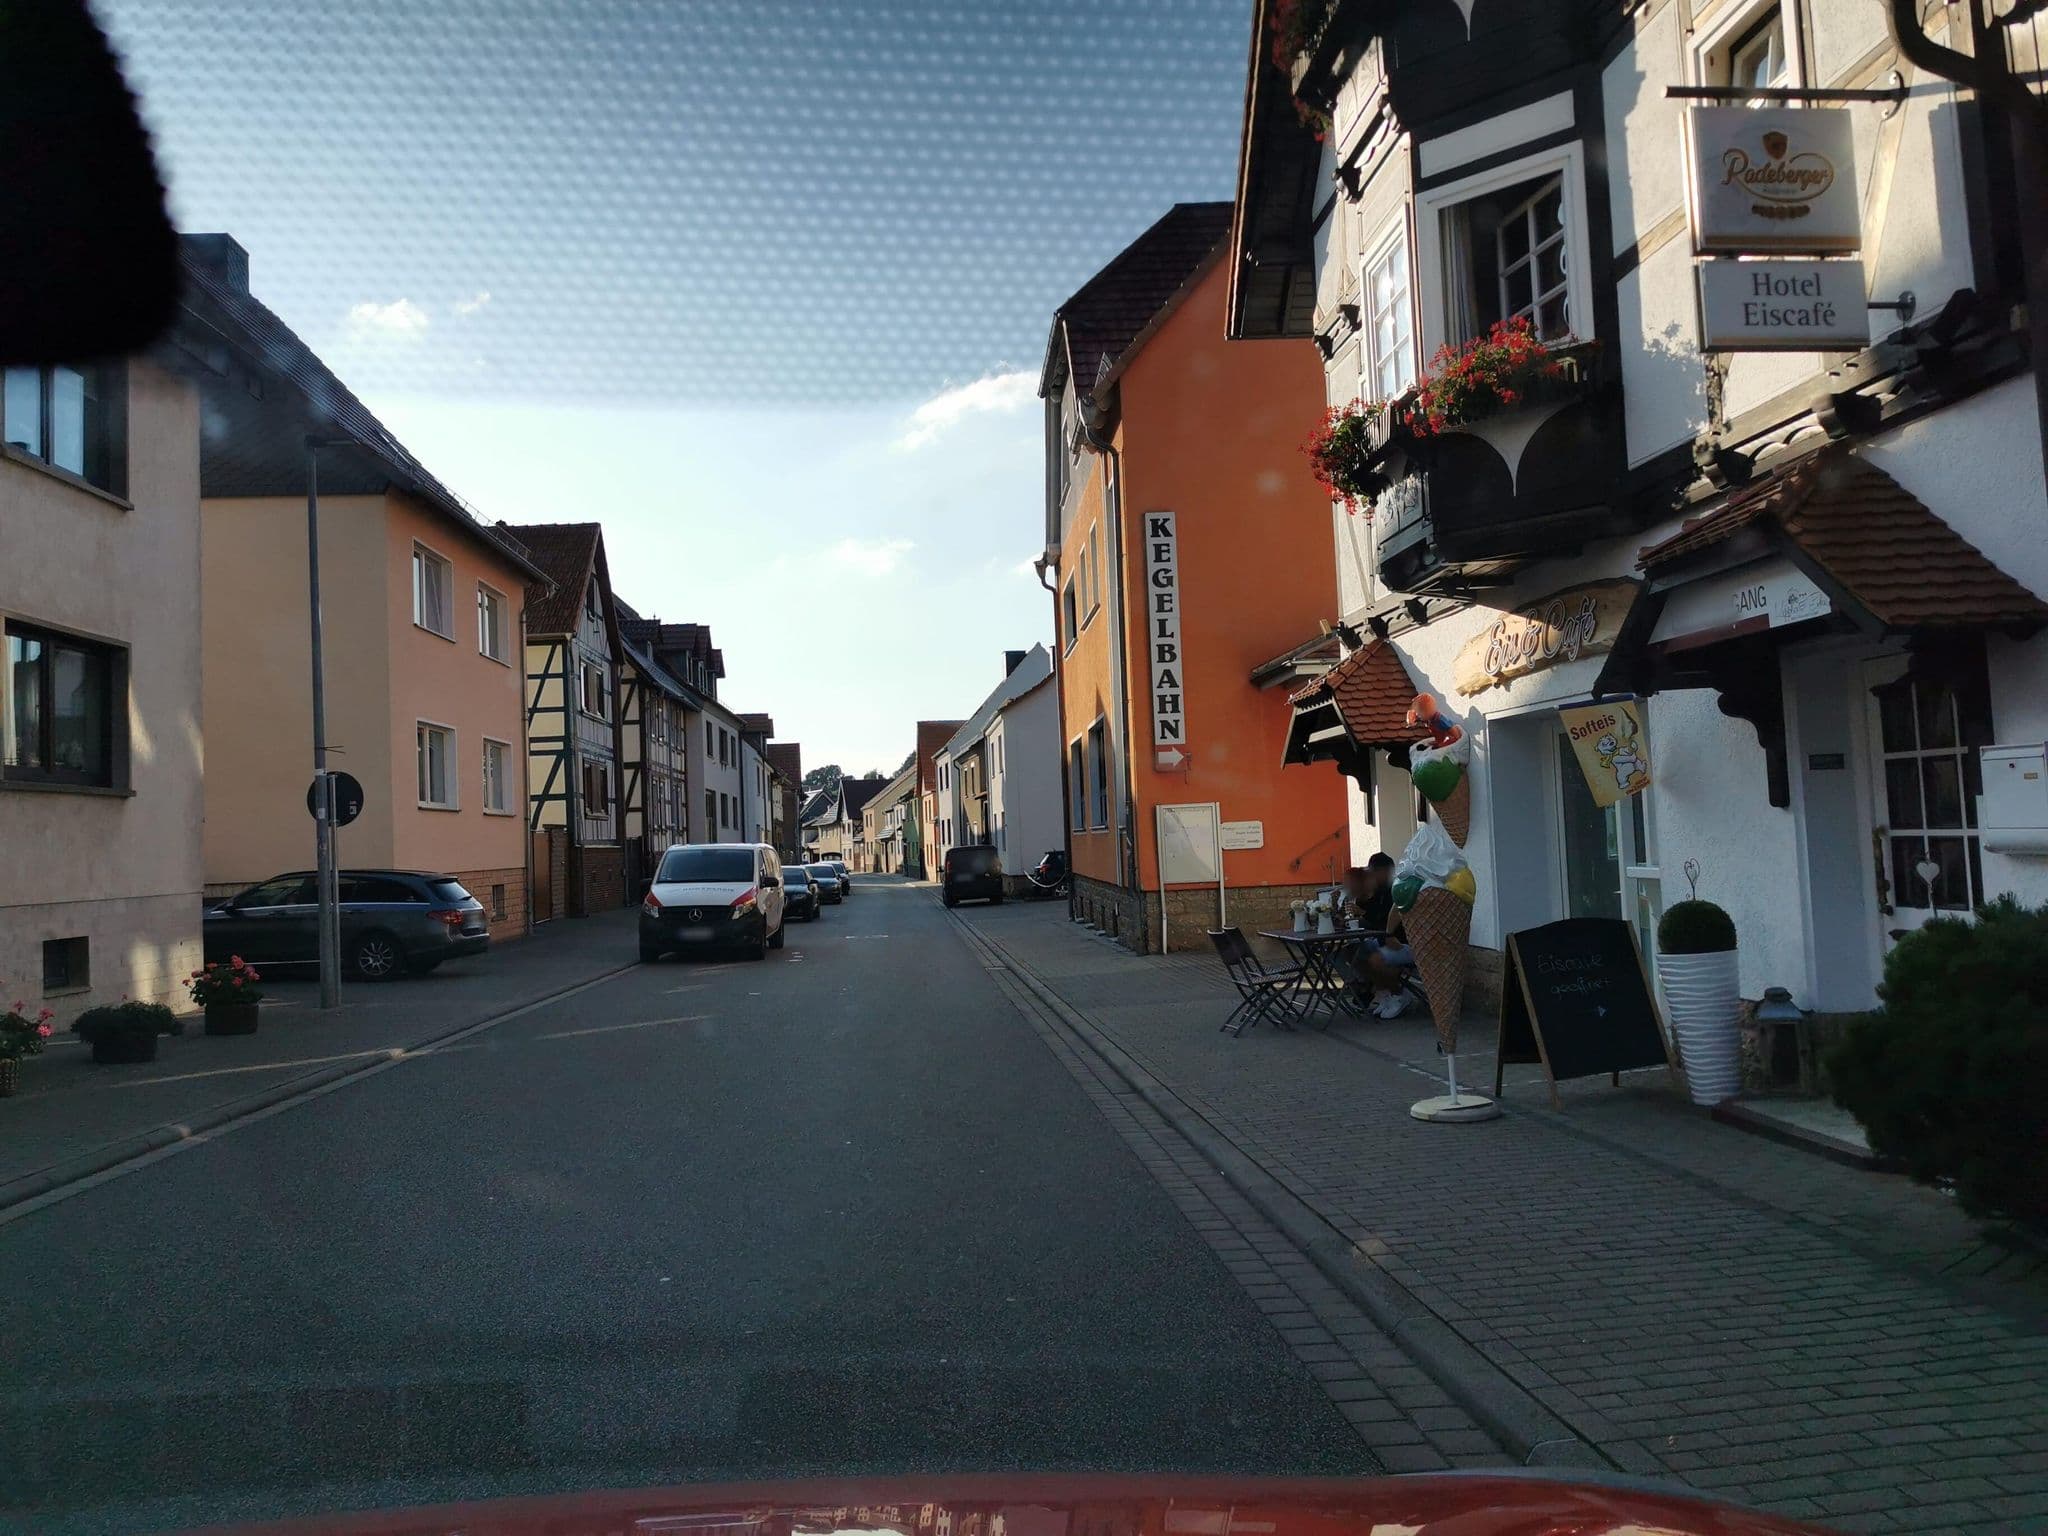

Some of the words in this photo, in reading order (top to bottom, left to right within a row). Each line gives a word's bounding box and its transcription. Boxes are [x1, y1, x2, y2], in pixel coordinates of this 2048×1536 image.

[1722, 148, 1834, 193] Radeberger
[1752, 272, 1822, 297] Hotel
[1742, 302, 1837, 327] Eiscafé
[1149, 517, 1181, 741] KEGELBAHN
[1541, 596, 1597, 661] Café
[1570, 714, 1616, 741] Softeis
